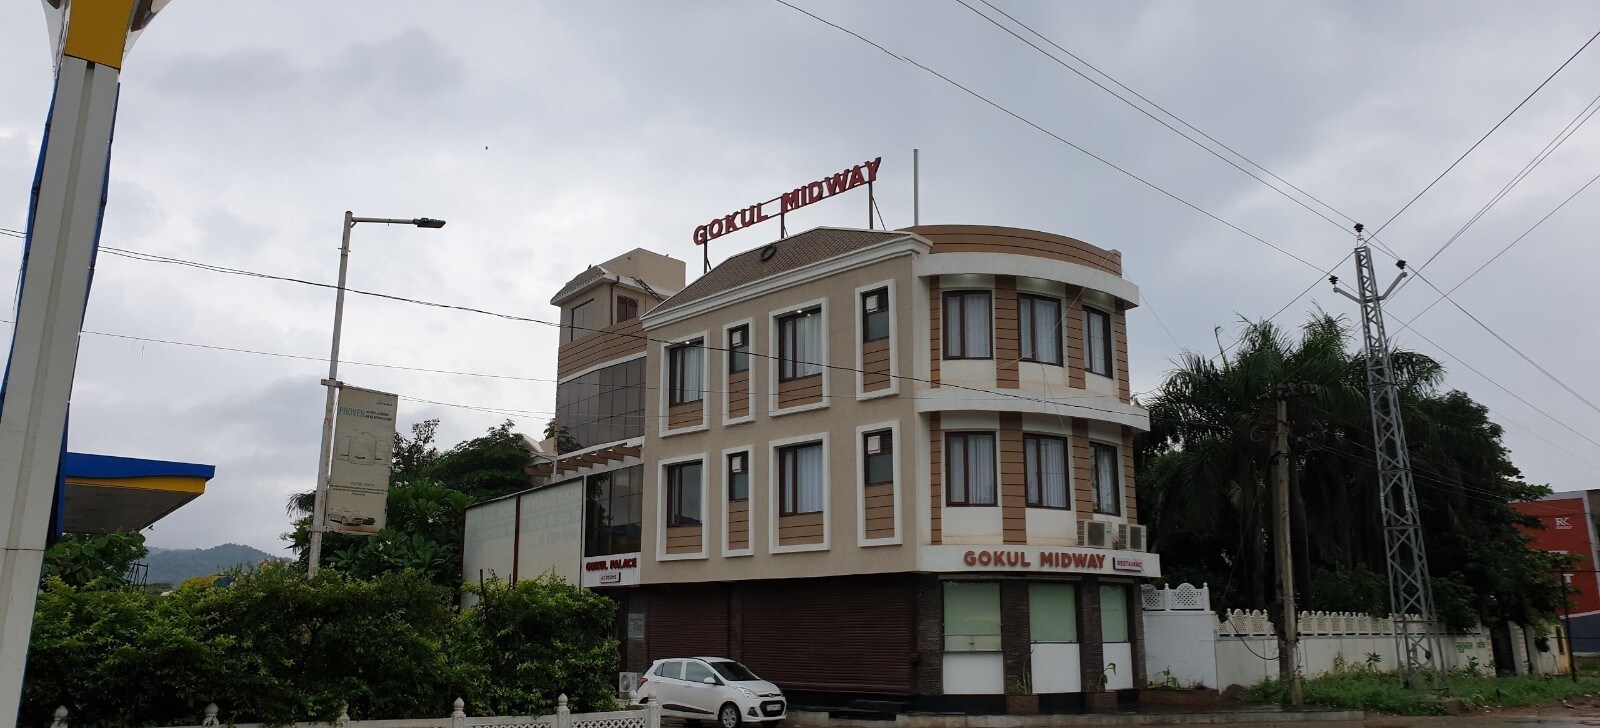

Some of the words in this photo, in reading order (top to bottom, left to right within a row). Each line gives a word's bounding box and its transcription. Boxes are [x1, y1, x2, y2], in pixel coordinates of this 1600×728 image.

[693, 203, 768, 245] GOKUL
[781, 157, 881, 213] MIDWAY
[338, 407, 365, 417] PROVEN
[610, 558, 637, 569] PALACE
[964, 551, 1031, 567] GOKUL
[1040, 552, 1106, 569] MIDWAY
